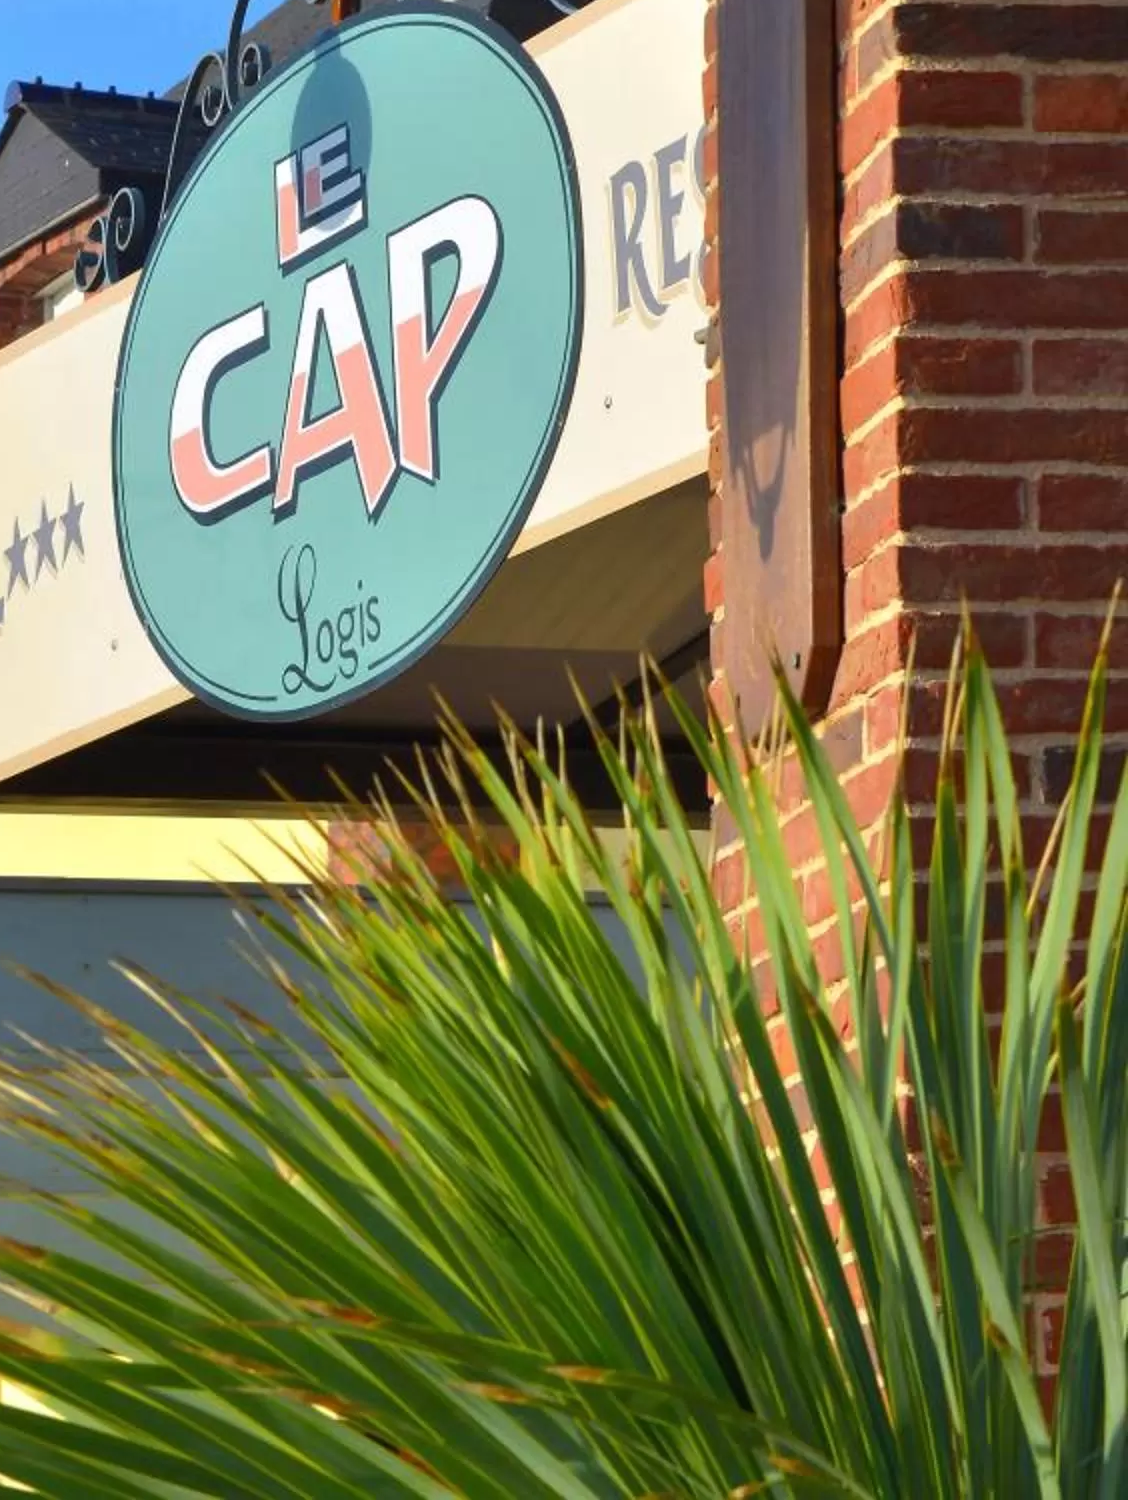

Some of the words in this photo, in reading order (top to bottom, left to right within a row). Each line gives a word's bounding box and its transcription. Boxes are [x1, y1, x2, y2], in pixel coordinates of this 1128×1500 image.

[274, 122, 368, 275] LE
[169, 193, 504, 526] CAP
[277, 543, 382, 696] Logis
